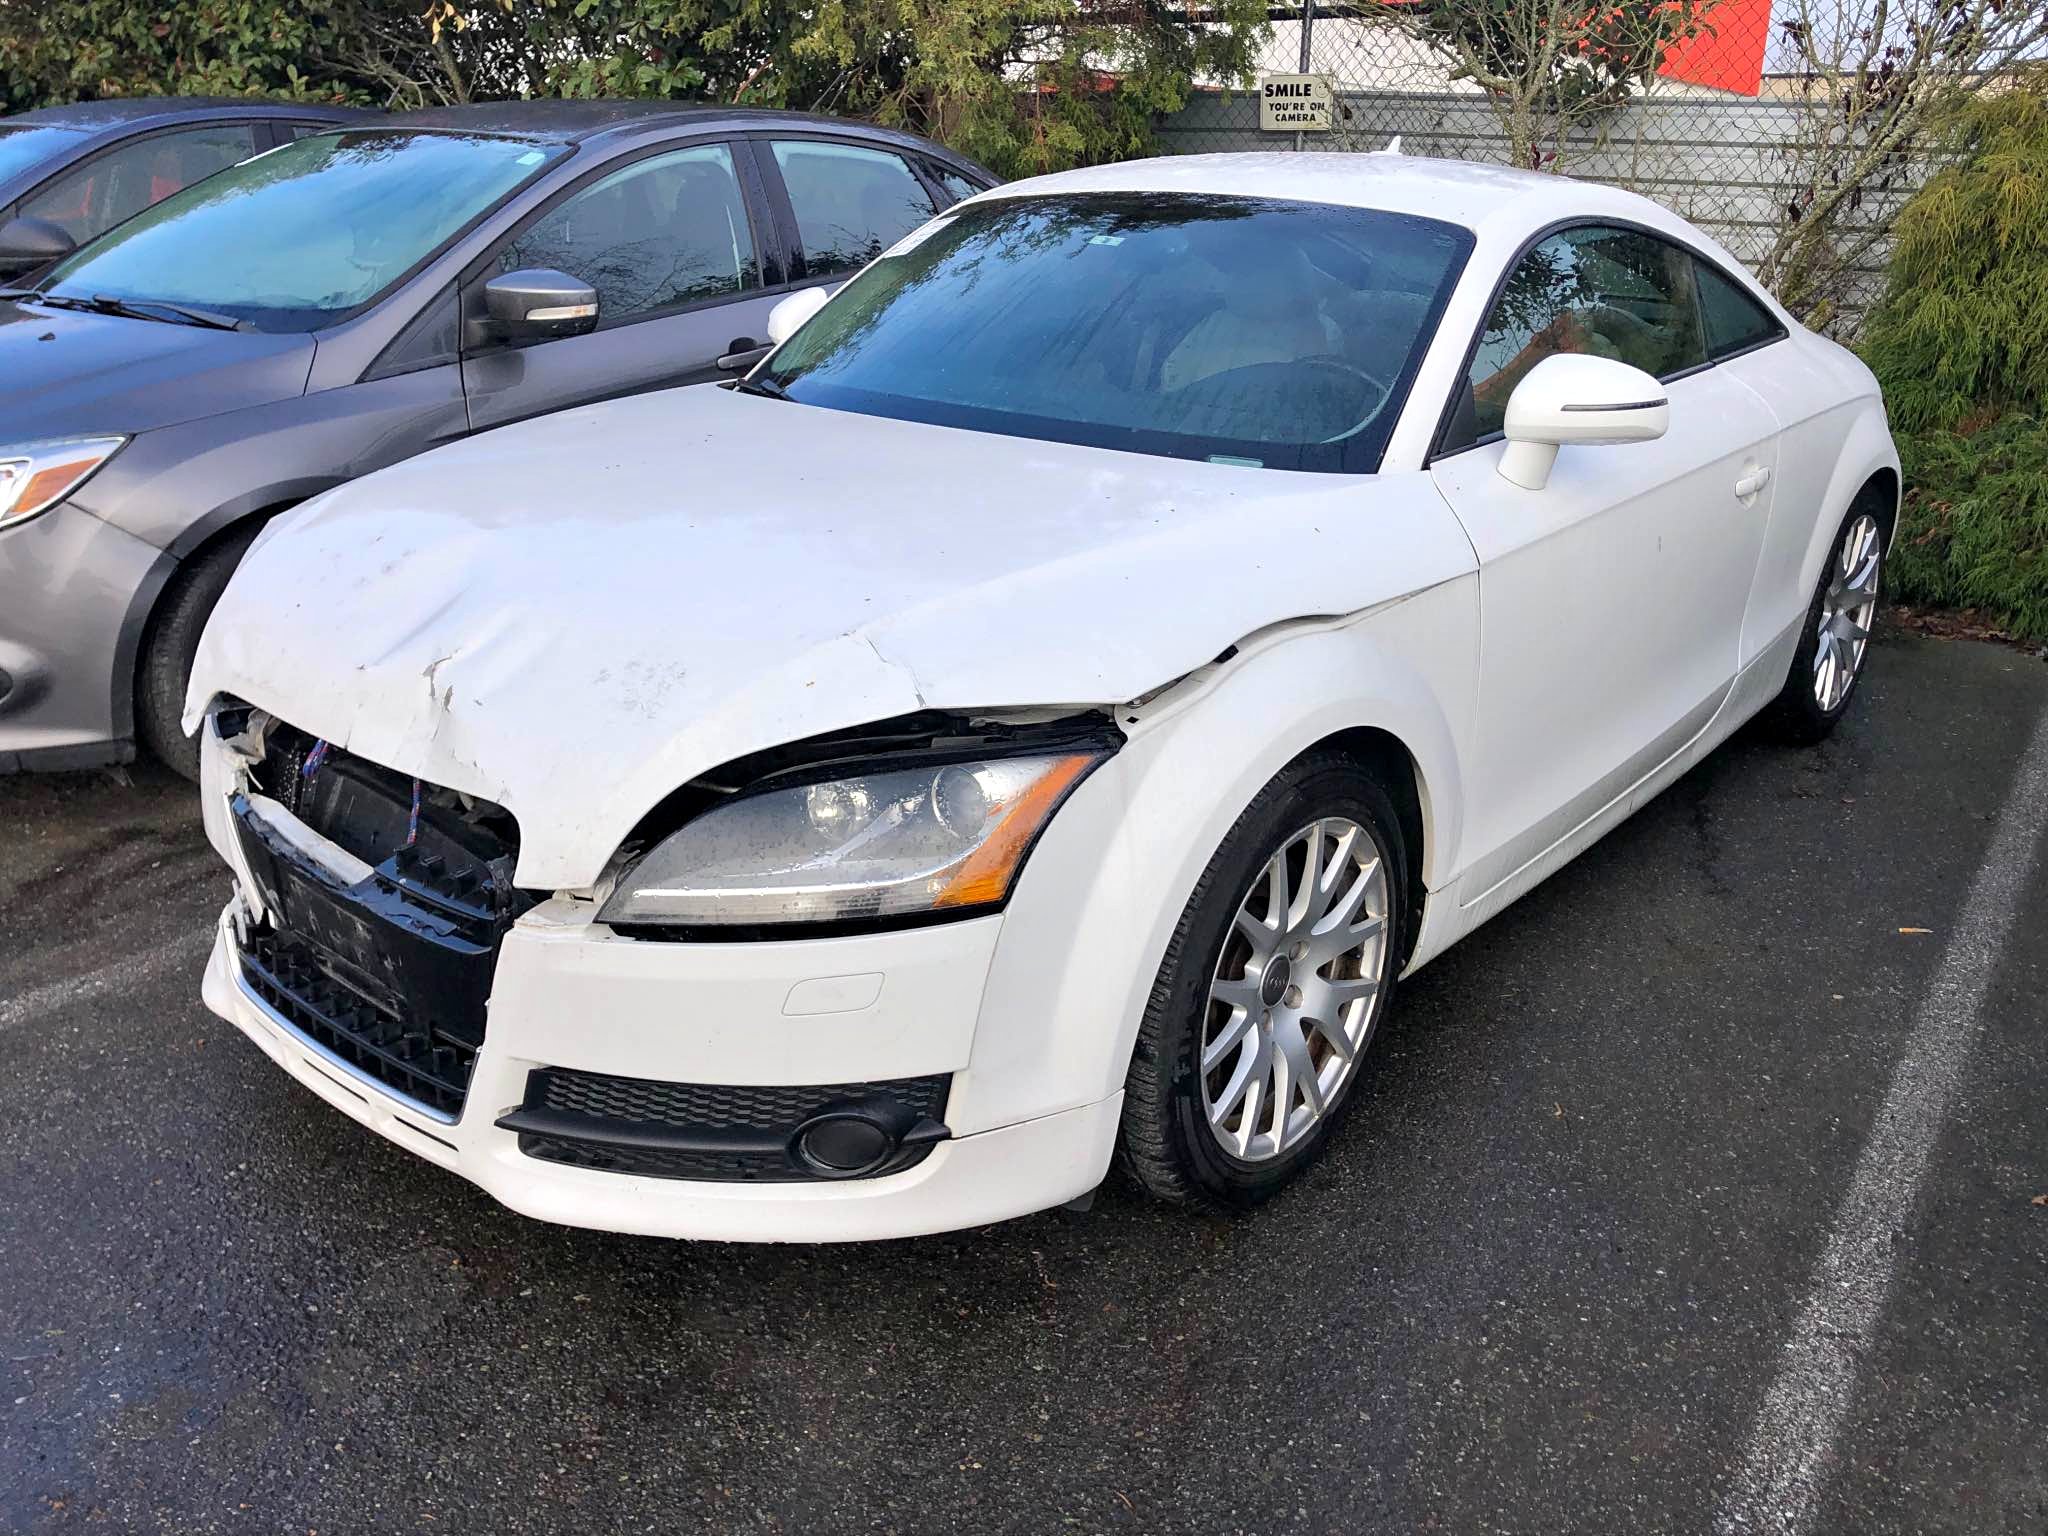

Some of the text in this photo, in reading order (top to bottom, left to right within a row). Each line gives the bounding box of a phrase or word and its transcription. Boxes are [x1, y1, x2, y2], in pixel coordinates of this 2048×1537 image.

[1265, 84, 1312, 97] SMILE
[1269, 102, 1325, 111] YOU'RE ON
[1275, 113, 1316, 122] CAMERA
